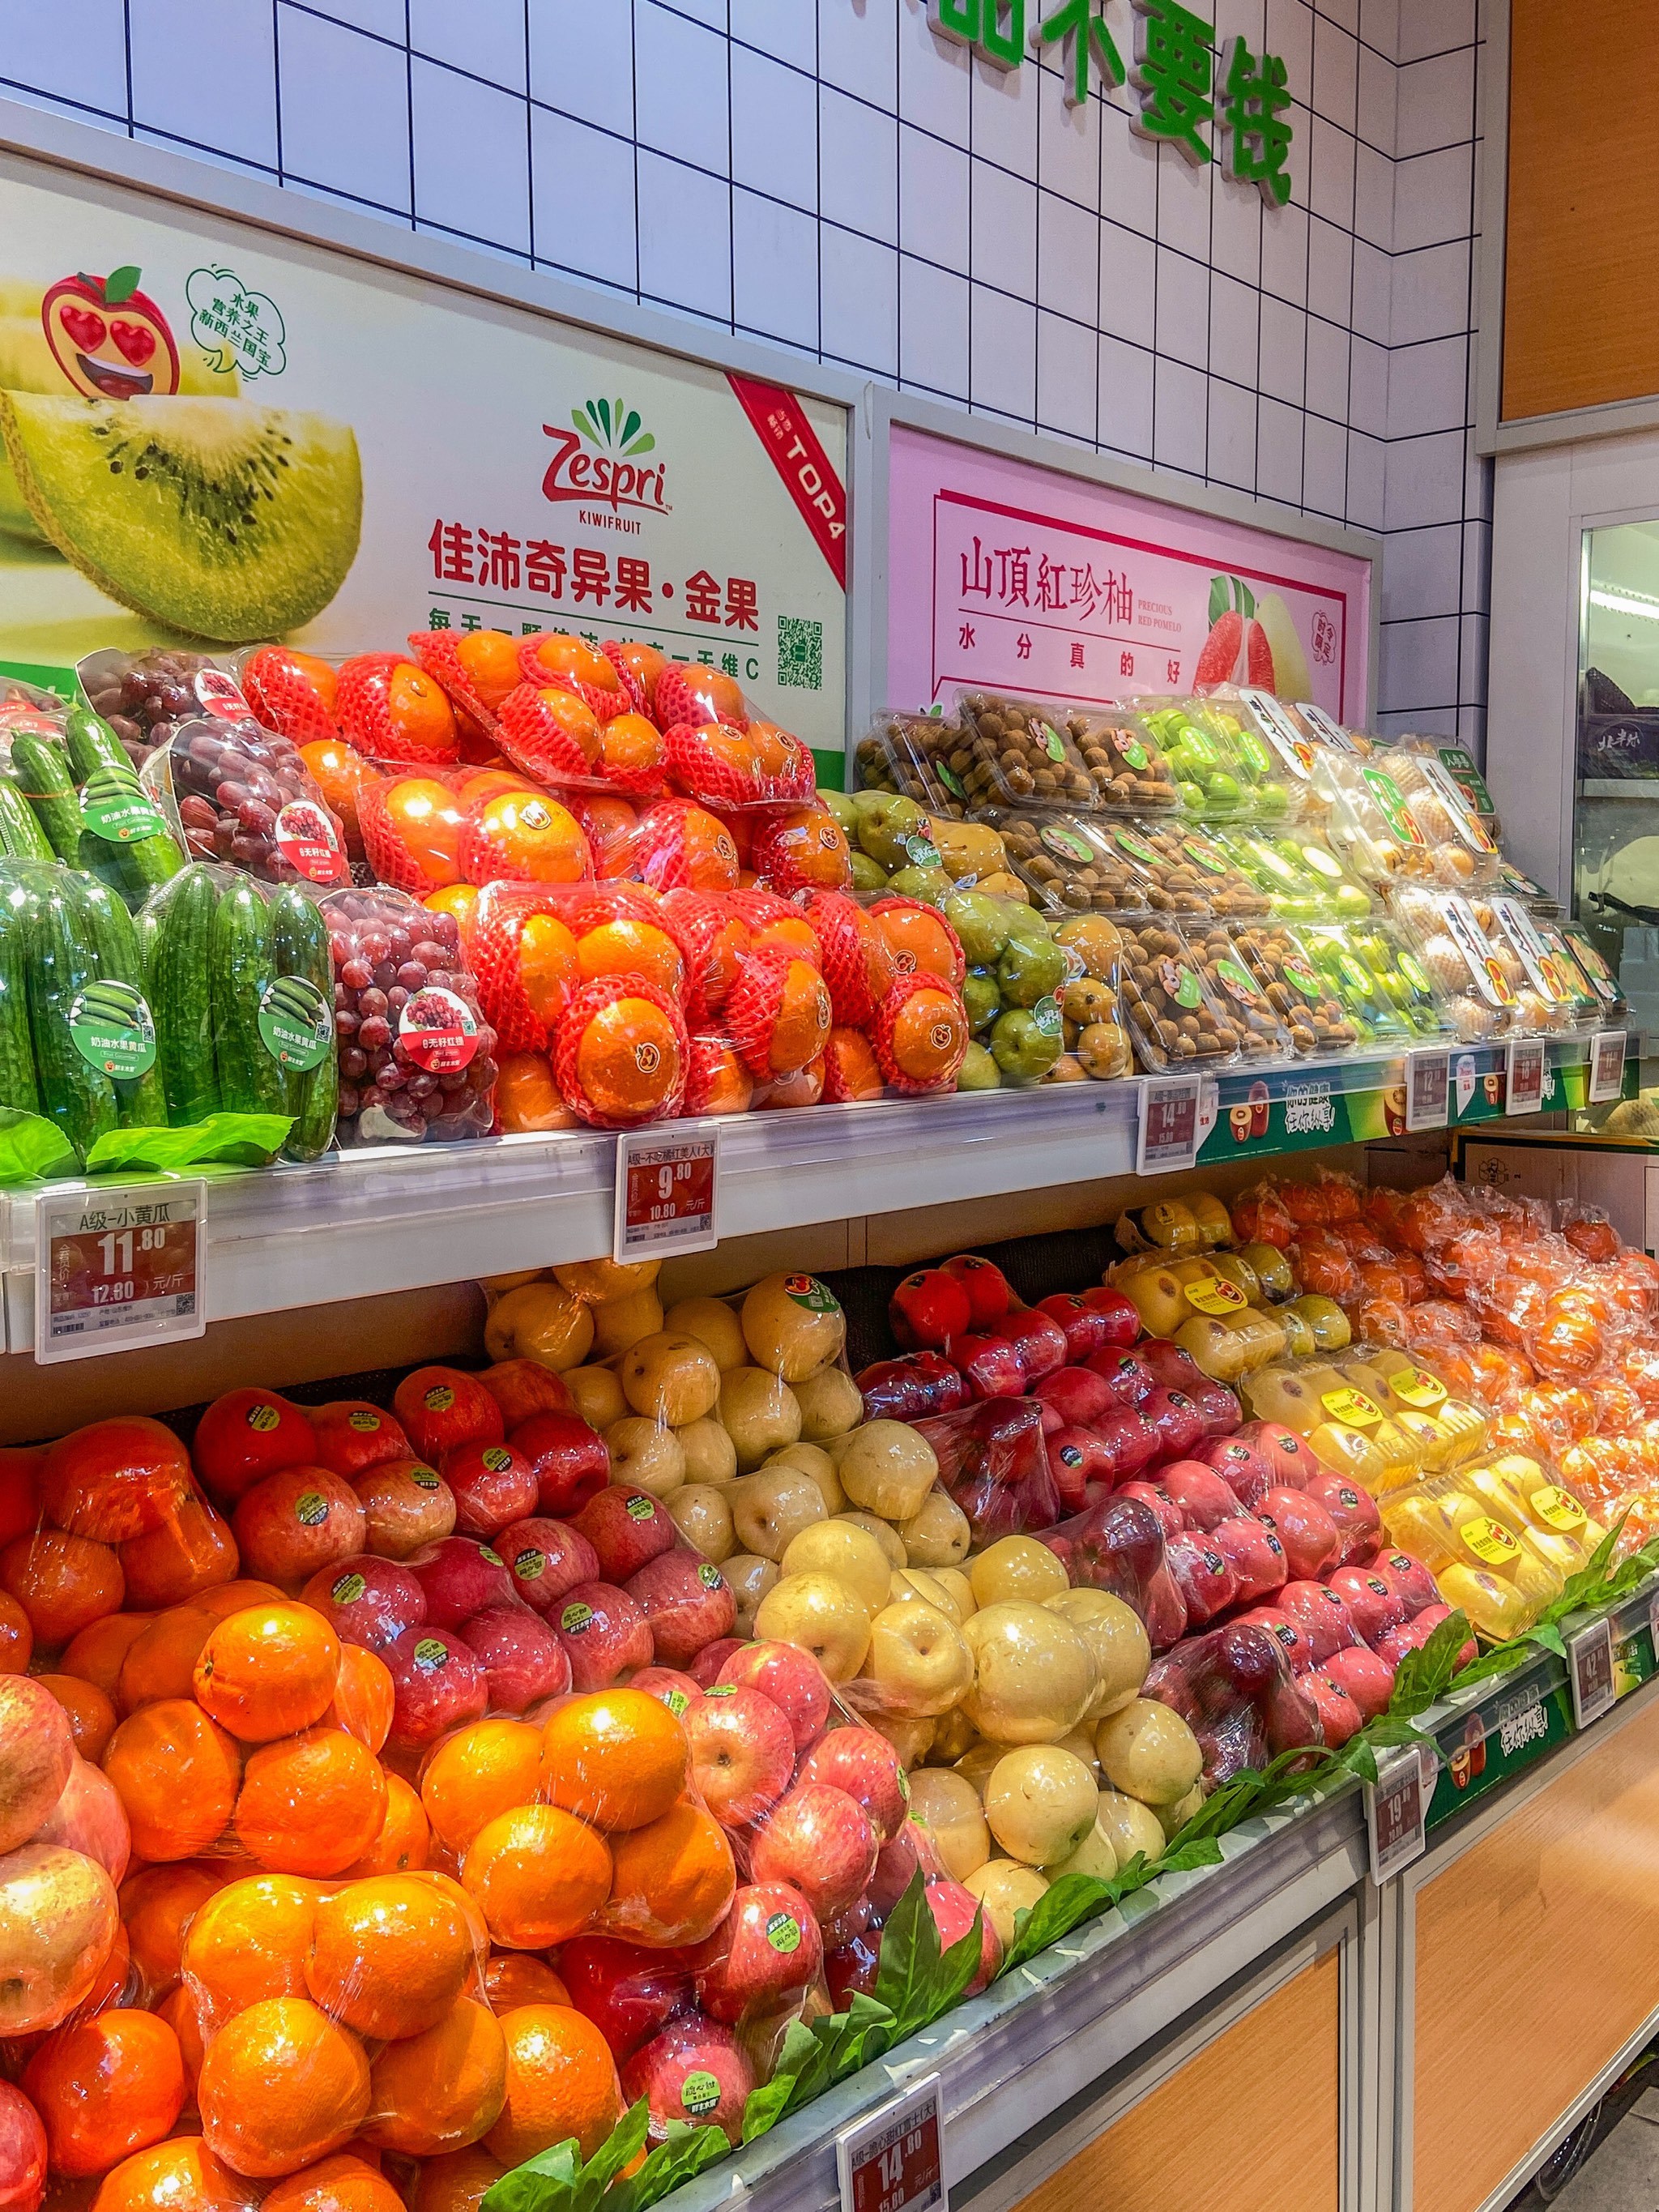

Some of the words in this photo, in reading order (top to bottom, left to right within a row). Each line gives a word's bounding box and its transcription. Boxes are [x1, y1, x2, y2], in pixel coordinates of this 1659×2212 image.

[230, 293, 259, 321] 水果
[211, 297, 269, 347] 营养之王
[199, 309, 271, 368] 新西兰国宝
[542, 424, 667, 513] Zespri
[578, 510, 642, 536] KIWIFRUIT
[428, 519, 759, 632] 佳沛奇异果·金果
[959, 536, 1132, 626] 山頂紅珍柚
[1138, 600, 1172, 616] PRECIOUS
[1138, 615, 1152, 626] RED
[1153, 618, 1182, 633] POMELO
[91, 1036, 147, 1053] 奶油水果黄瓜
[272, 1025, 317, 1050] 奶油水果黄瓜
[659, 1163, 692, 1199] 9.80
[79, 1203, 170, 1231] A级-小黄瓜
[650, 1203, 676, 1220] 10.80
[686, 1198, 706, 1212] 元/斤
[97, 1228, 166, 1275] 11.80
[152, 1274, 184, 1291] 元/斤
[877, 2129, 922, 2192] 14.80
